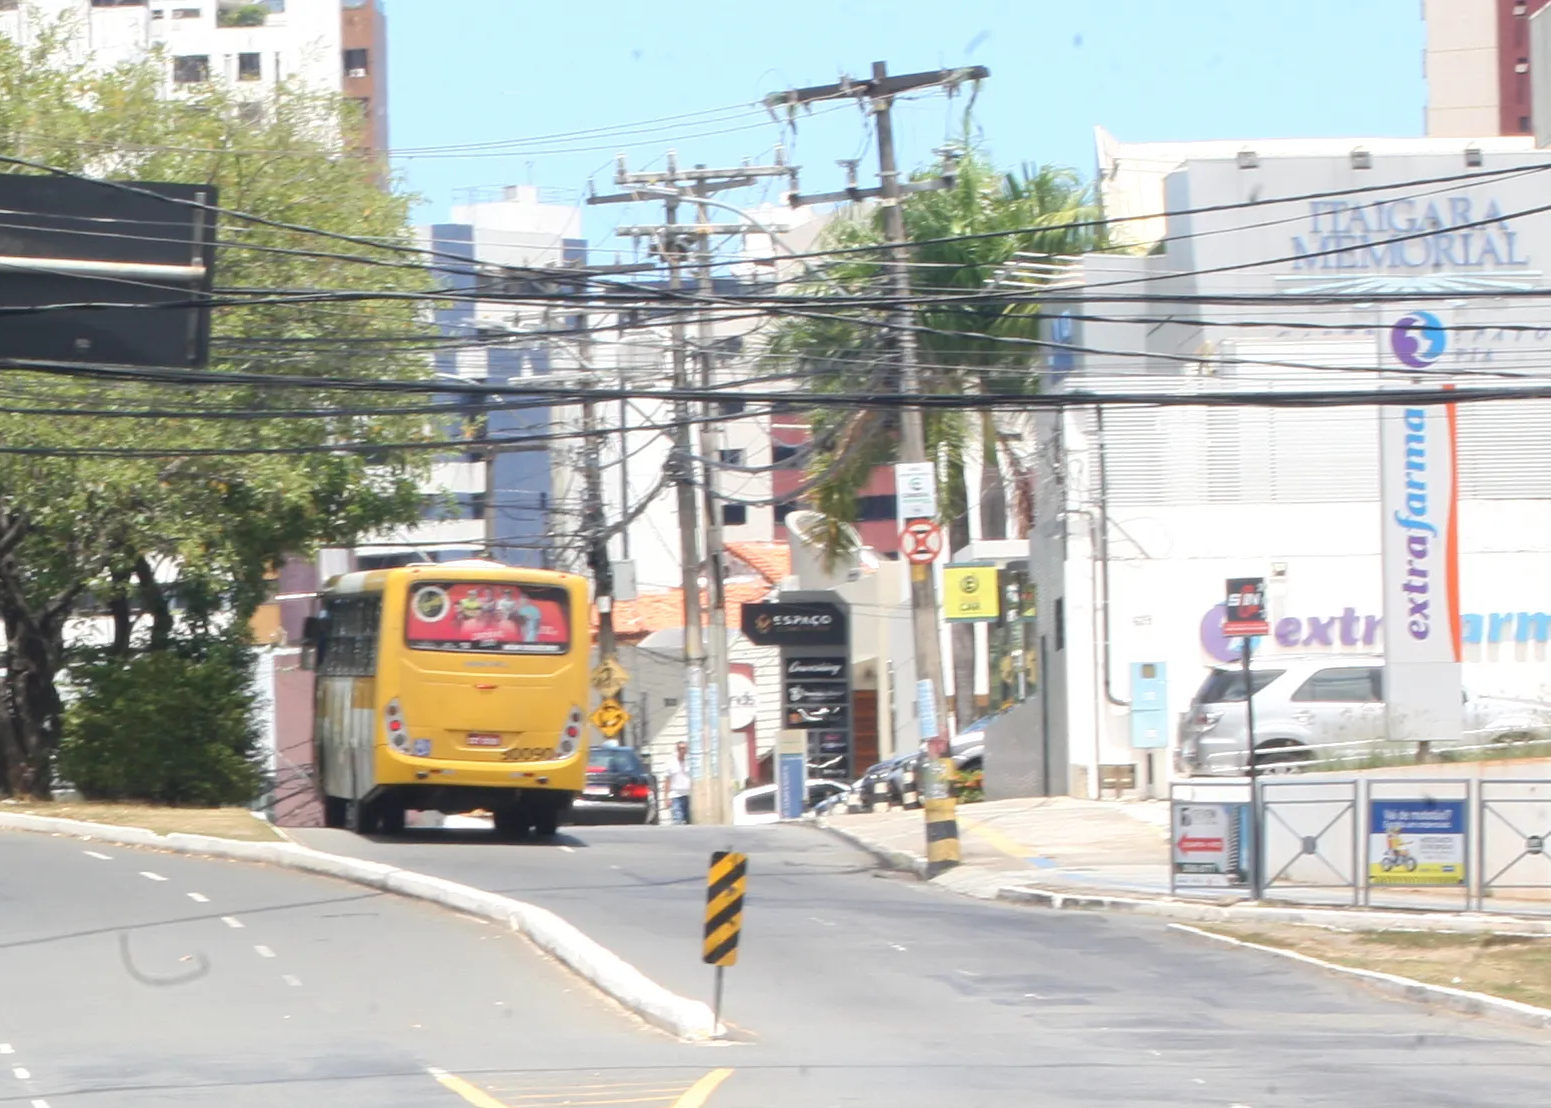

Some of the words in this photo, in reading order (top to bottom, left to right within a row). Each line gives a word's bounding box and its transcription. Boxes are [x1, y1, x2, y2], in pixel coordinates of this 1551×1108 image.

[1308, 196, 1509, 234] ITAIGARA
[1290, 231, 1530, 269] MEMORIAL
[1394, 408, 1438, 640] extrafarma
[772, 614, 833, 628] ESPAÇO
